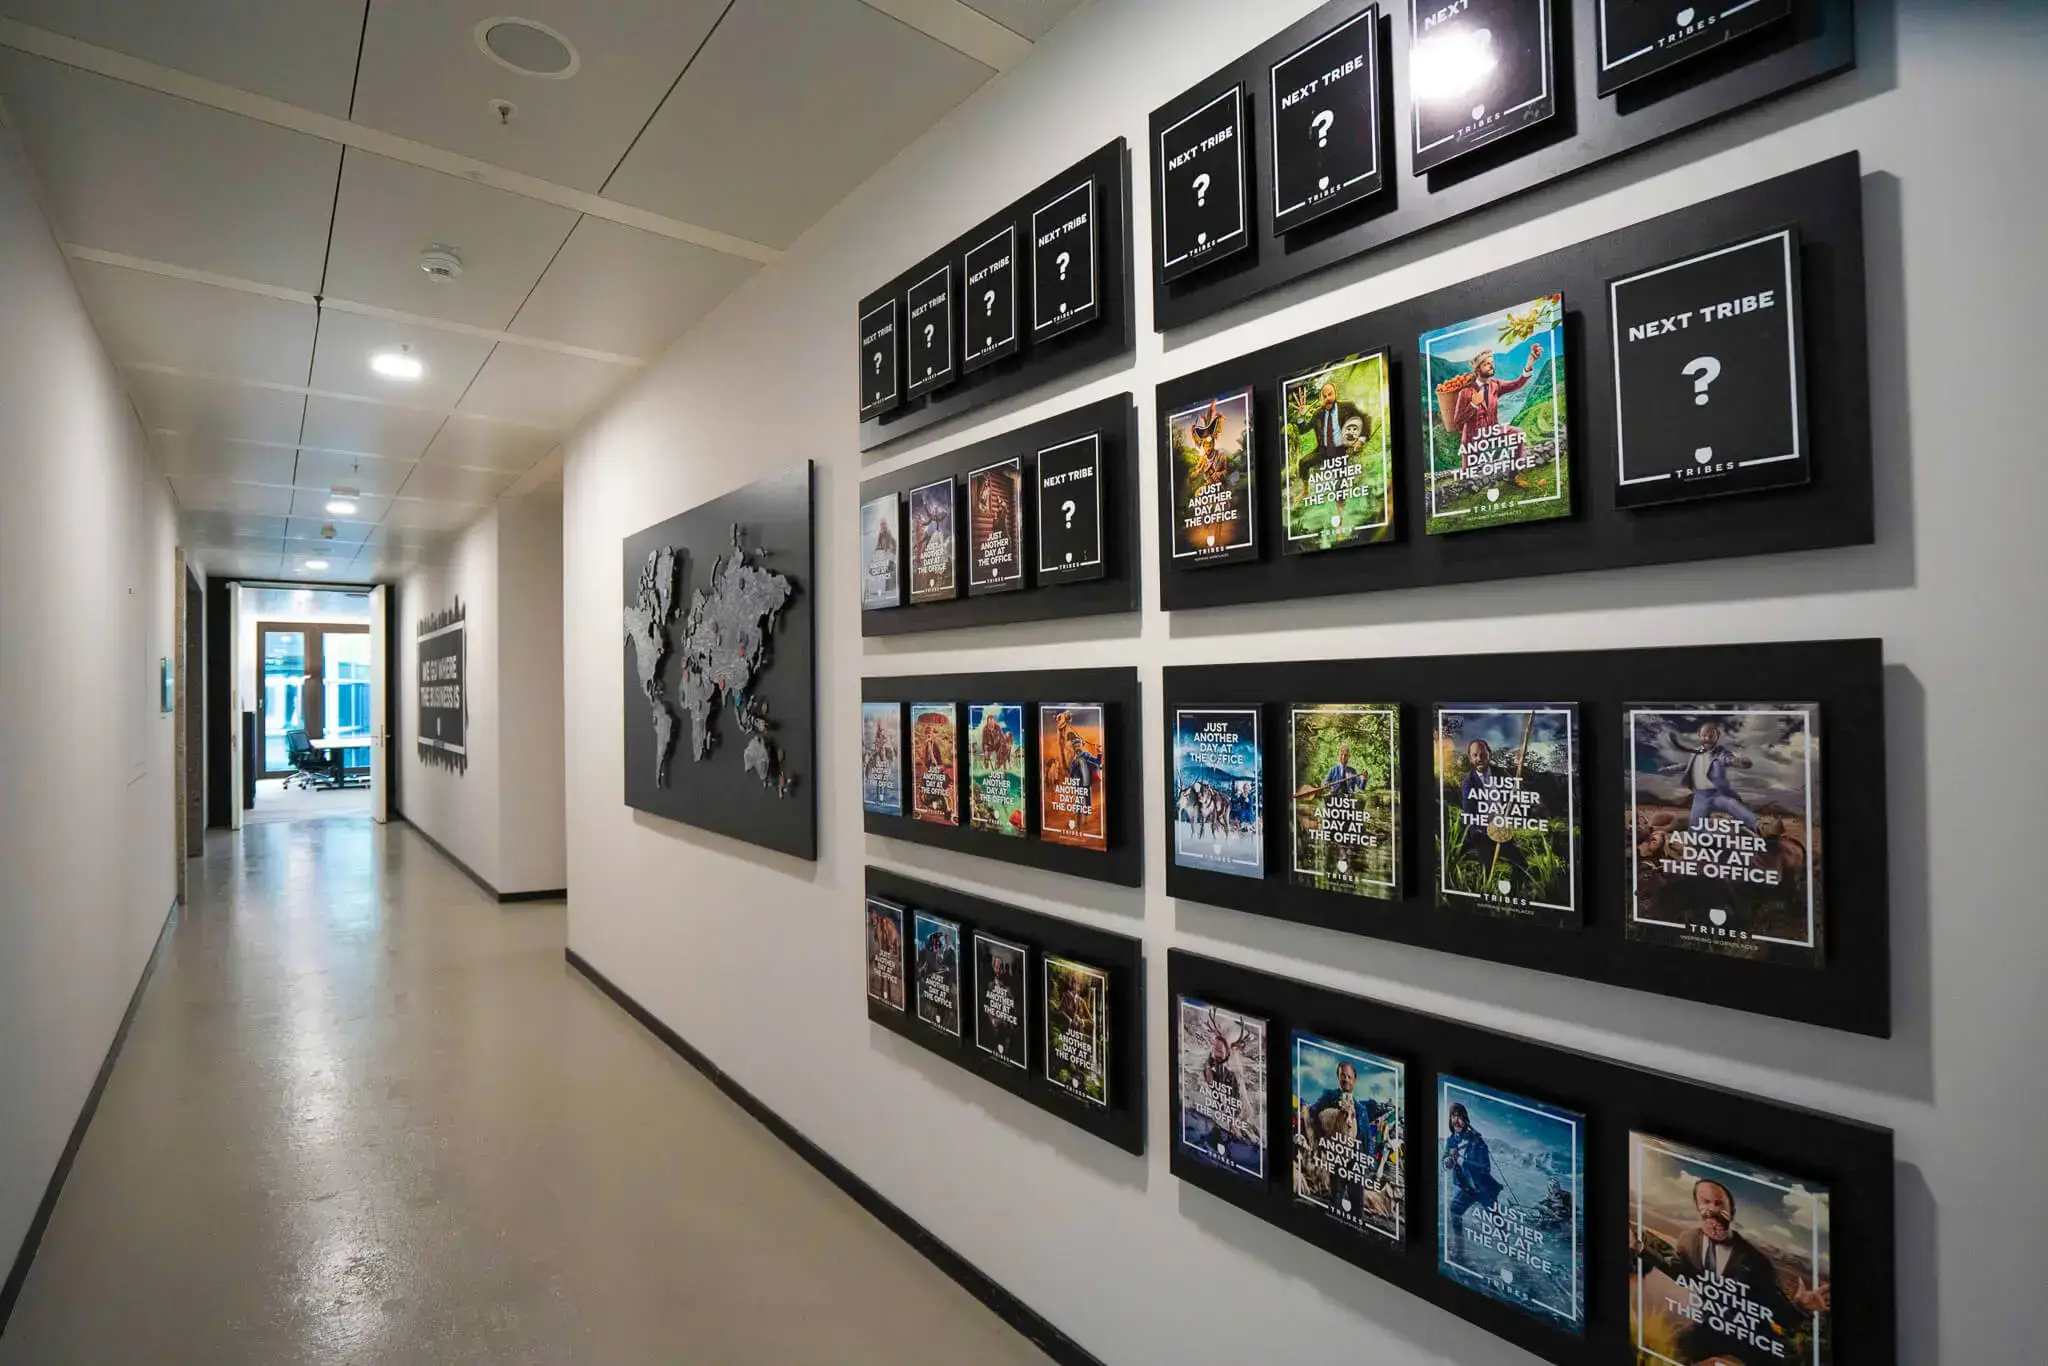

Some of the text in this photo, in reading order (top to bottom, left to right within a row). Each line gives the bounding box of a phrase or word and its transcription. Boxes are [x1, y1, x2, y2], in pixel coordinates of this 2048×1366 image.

[1425, 0, 1468, 31] NEXT
[1658, 15, 1716, 48] TRIBES
[1281, 55, 1364, 109] NEXT TRIBE
[1311, 109, 1334, 148] ?
[1457, 112, 1501, 137] TRIBES
[1169, 126, 1233, 171] NEXT TRIBE
[1192, 173, 1211, 207] ?
[1308, 184, 1341, 204] TRIBES
[1038, 213, 1088, 248] NEXT TRIBE
[1189, 240, 1217, 257] TRIBES
[969, 255, 1010, 286] NEXT TRIBE
[1056, 251, 1070, 281] ?
[911, 292, 947, 319] NEXT TRIBE
[1629, 290, 1775, 342] NEXT TRIBE
[863, 323, 893, 347] NEXT TRIBE
[1681, 356, 1721, 406] ?
[1472, 423, 1510, 440] JUST
[1458, 432, 1526, 456] ANOTHER
[1320, 456, 1349, 470] JUST
[1467, 446, 1518, 466] DAY AT
[1043, 466, 1093, 489] NEXT TRIBE
[1309, 464, 1362, 484] ANOTHER
[1450, 456, 1536, 481] THE OFFICE
[1676, 462, 1734, 479] TRIBES
[1198, 483, 1221, 496] JUST
[1316, 477, 1354, 493] DAY AT
[1188, 491, 1232, 508] ANOTHER
[1303, 486, 1369, 507] THE OFFICE
[1061, 500, 1076, 529] ?
[1195, 503, 1226, 516] DAY AT
[1473, 501, 1514, 513] TRIBES
[1184, 510, 1237, 528] THE OFFICE
[981, 538, 1008, 550] ANOTHER
[987, 531, 1002, 541] JUST
[985, 547, 1005, 557] DAY AT
[991, 554, 1012, 564] OFFICE
[1198, 546, 1224, 555] TRIBES
[1204, 723, 1228, 732] JUST
[1194, 732, 1238, 743] ANOTHER
[1200, 743, 1232, 753] DAY AT
[1190, 753, 1243, 764] THE OFFICE
[923, 772, 946, 780] ANOTHER
[982, 779, 1010, 788] ANOTHER
[1063, 777, 1080, 786] JUST
[1483, 776, 1523, 789] JUST
[1055, 785, 1088, 796] ANOTHER
[1060, 794, 1074, 802] DAY
[1468, 788, 1540, 804] ANOTHER
[1051, 802, 1092, 814] THE OFFICE
[1327, 797, 1357, 809] JUST
[1478, 802, 1530, 816] DAY AT
[1314, 808, 1370, 822] ANOTHER
[1461, 813, 1548, 831] THE OFFICE
[1322, 820, 1363, 833] DAY AT
[1691, 818, 1744, 834] JUST
[1309, 829, 1377, 847] THE OFFICE
[1670, 831, 1767, 852] ANOTHER
[1683, 847, 1753, 866] DAY AT
[1660, 859, 1779, 885] THE OFFICE
[1483, 894, 1526, 905] TRIBES
[1690, 924, 1747, 939] TRIBES
[986, 990, 1014, 1008] ANOTHER
[990, 1000, 1010, 1013] DAY AT
[984, 1004, 1017, 1025] THE OFFICE
[1066, 1028, 1083, 1038] JUST
[1059, 1033, 1092, 1053] ANOTHER
[1063, 1044, 1087, 1059] DAY AT
[1056, 1048, 1068, 1060] THE
[1199, 1087, 1241, 1107] ANOTHER
[1210, 1080, 1232, 1096] JUST
[1206, 1097, 1238, 1117] DAY AT
[1195, 1103, 1248, 1131] THE OFFICE
[1332, 1132, 1362, 1149] JUST
[1319, 1138, 1374, 1167] ANOTHER
[1327, 1151, 1368, 1175] DAY AT
[1314, 1158, 1381, 1192] THE OFFICE
[1488, 1202, 1526, 1223] JUST
[1472, 1207, 1544, 1245] ANOTHER
[1482, 1222, 1533, 1252] DAY AT
[1465, 1228, 1552, 1274] THE OFFICE
[1486, 1277, 1528, 1300] TRIBES
[1696, 1269, 1750, 1296] JUST
[1676, 1274, 1776, 1323] ANOTHER
[1689, 1291, 1760, 1330] DAY AT
[1665, 1297, 1785, 1358] THE OFFICE
